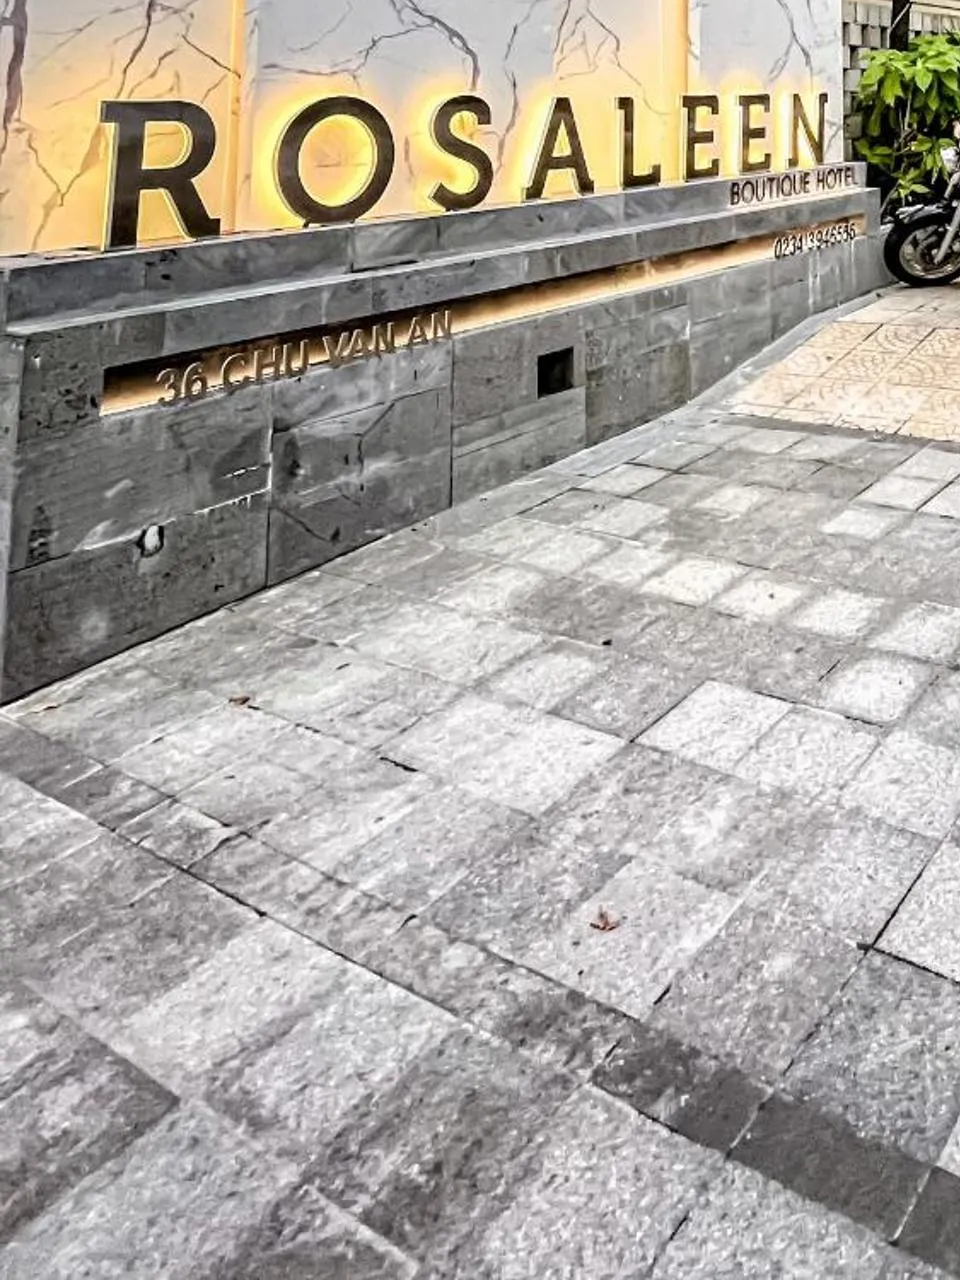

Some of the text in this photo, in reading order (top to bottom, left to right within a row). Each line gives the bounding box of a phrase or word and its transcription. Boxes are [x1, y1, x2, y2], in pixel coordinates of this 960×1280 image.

[101, 93, 829, 251] ROSALEEN
[730, 166, 859, 206] BOUTIQUE HOTEL
[156, 309, 453, 407] 36 CHU VAN AN
